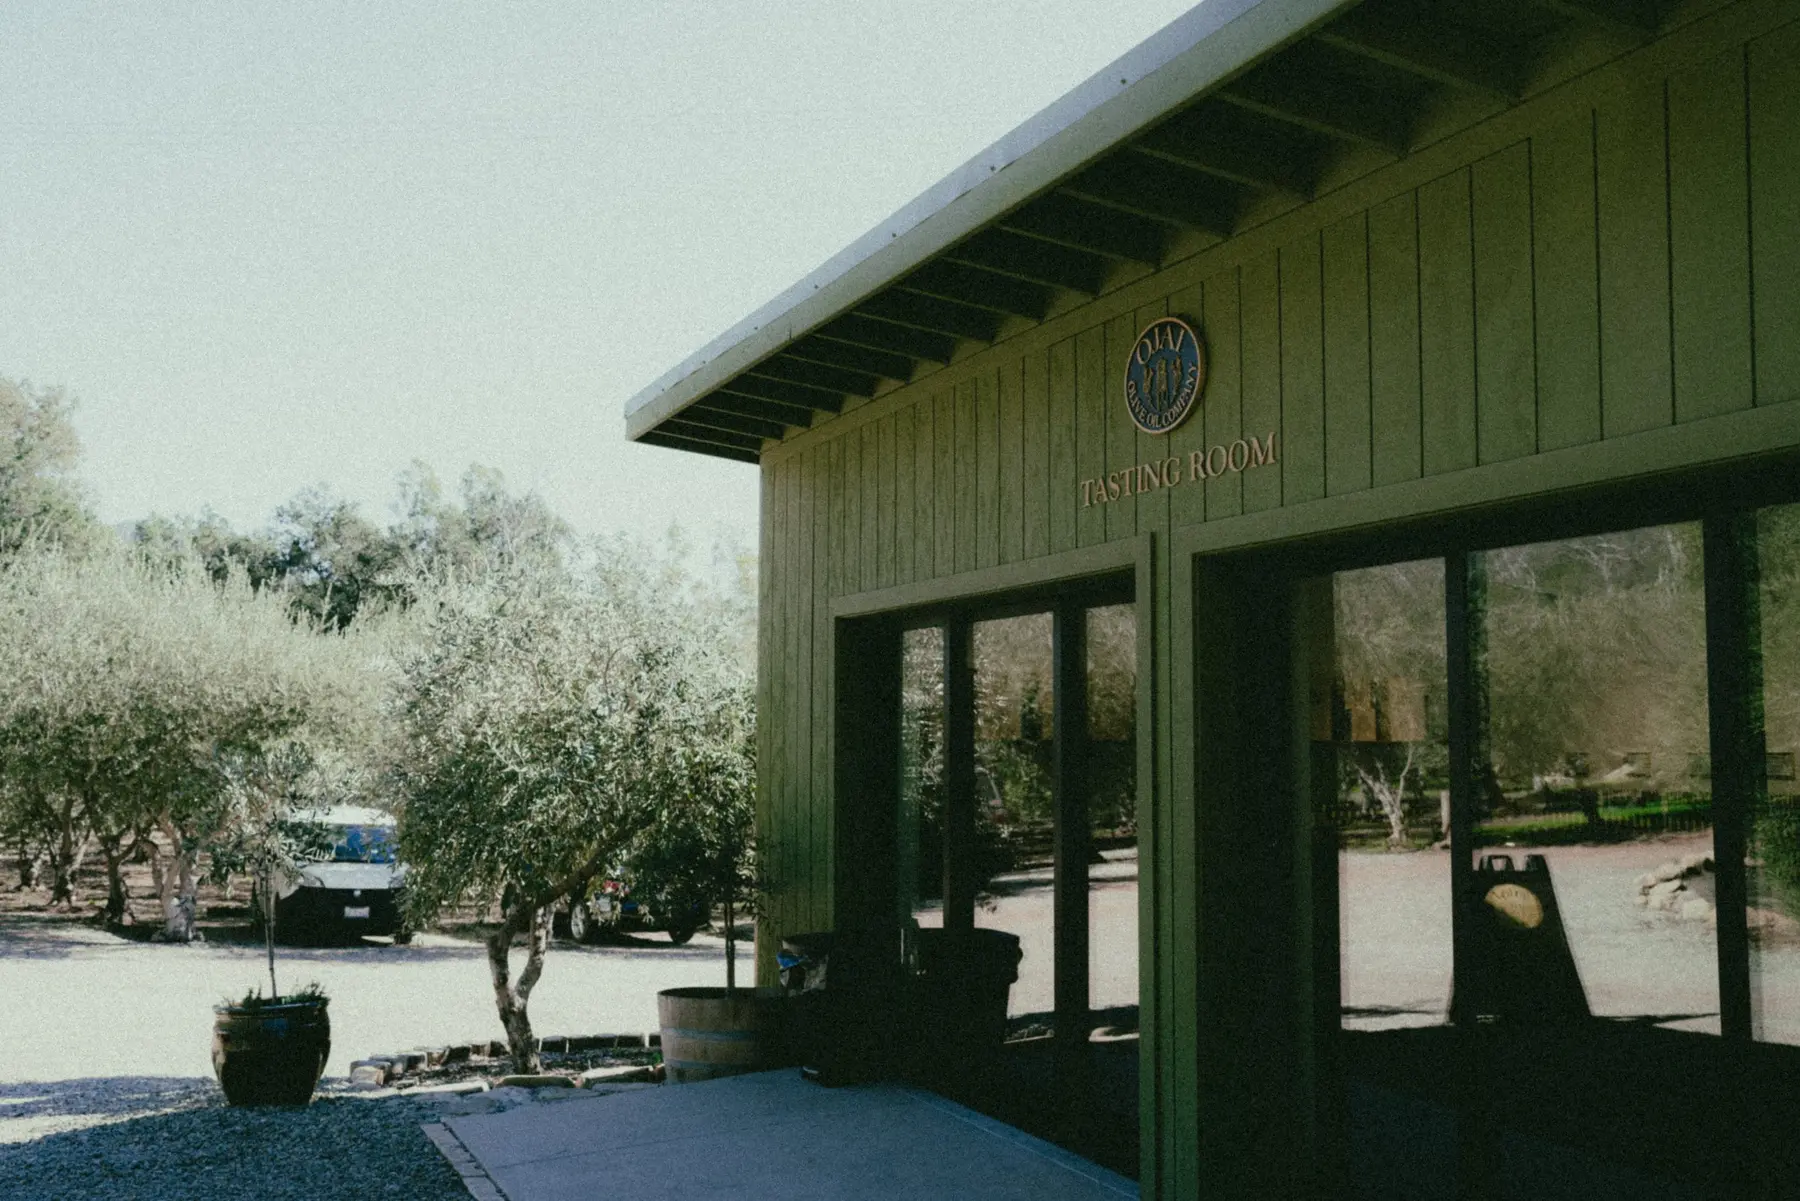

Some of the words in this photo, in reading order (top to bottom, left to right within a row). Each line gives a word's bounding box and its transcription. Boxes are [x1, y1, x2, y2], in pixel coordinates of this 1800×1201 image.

[1136, 324, 1185, 365] OJAI
[1128, 380, 1148, 422] OLIVE
[1146, 413, 1162, 427] OIL
[1162, 361, 1197, 424] COMPANY
[1080, 457, 1181, 508] TASTING
[1188, 431, 1277, 481] ROOM
